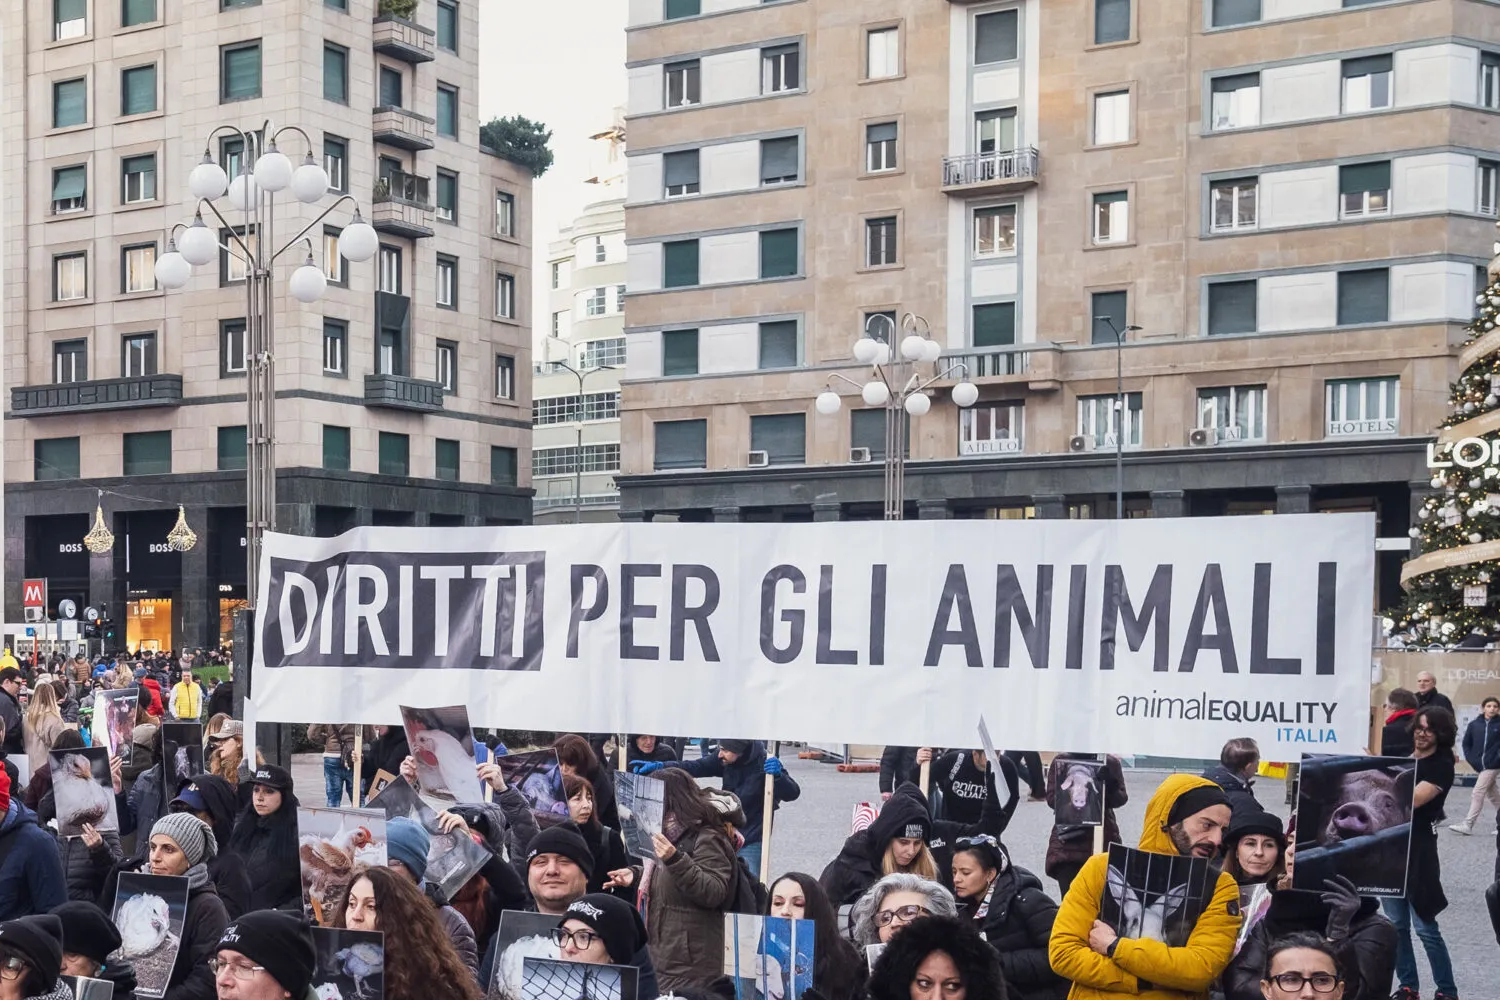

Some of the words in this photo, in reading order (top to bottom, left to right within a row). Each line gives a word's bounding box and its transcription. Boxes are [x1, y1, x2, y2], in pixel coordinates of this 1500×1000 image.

[1330, 420, 1395, 435] HOTELS
[965, 441, 1018, 454] AIELLO
[59, 543, 83, 553] BOSS
[24, 585, 42, 602] M
[278, 563, 528, 658] DIRITTI
[565, 562, 721, 663] PER
[759, 563, 888, 666] GLI
[923, 561, 1338, 675] ANIMALI
[1115, 690, 1339, 725] animalEQUALITY
[1275, 727, 1339, 744] ITALIA
[952, 780, 988, 795] anima
